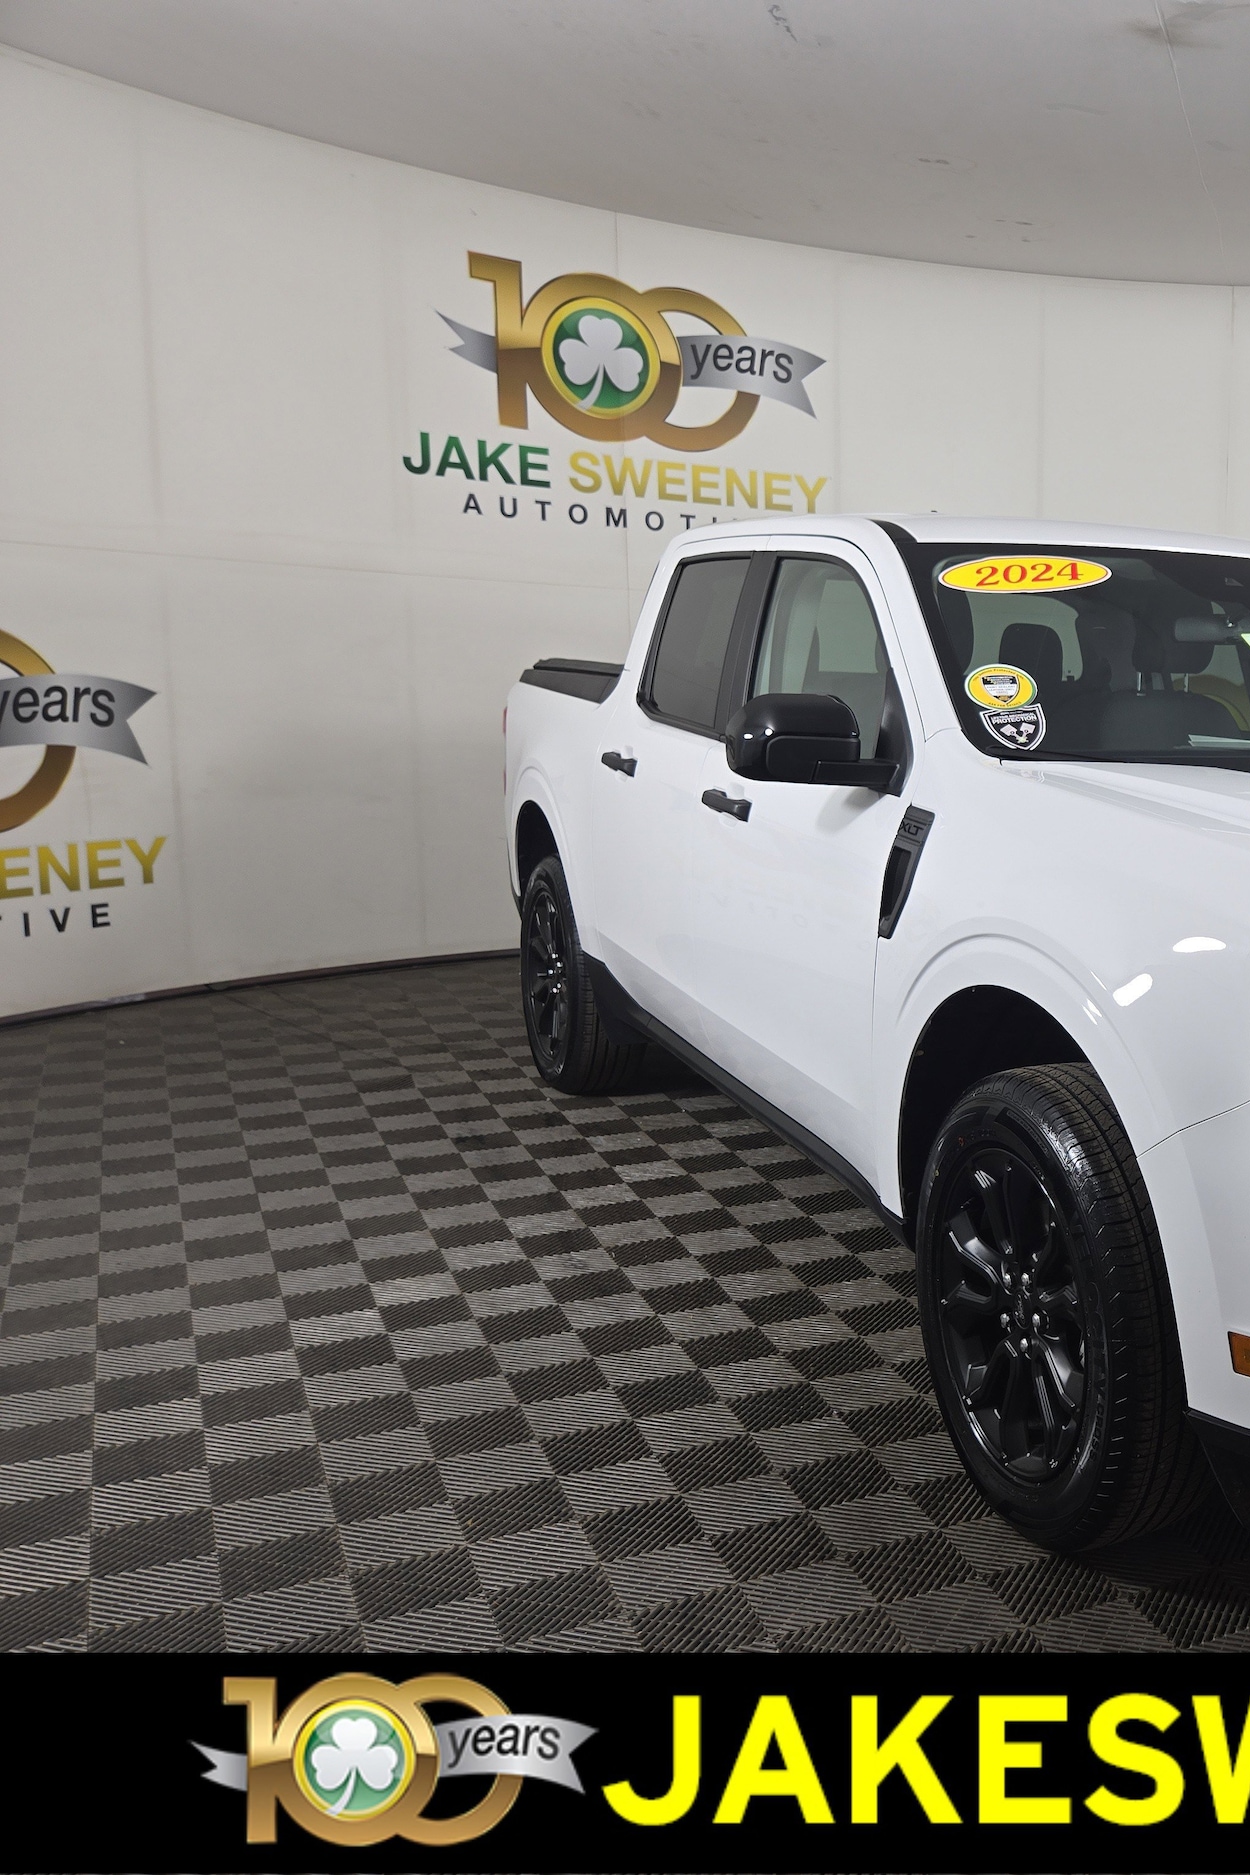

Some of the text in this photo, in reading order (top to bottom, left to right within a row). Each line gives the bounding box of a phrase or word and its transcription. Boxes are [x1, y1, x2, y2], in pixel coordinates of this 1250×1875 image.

[690, 339, 794, 385] years
[402, 431, 829, 514] JAKE SWEENEY
[463, 493, 720, 531] AUTOMOT
[975, 562, 1084, 587] 2024
[900, 821, 924, 836] XLT
